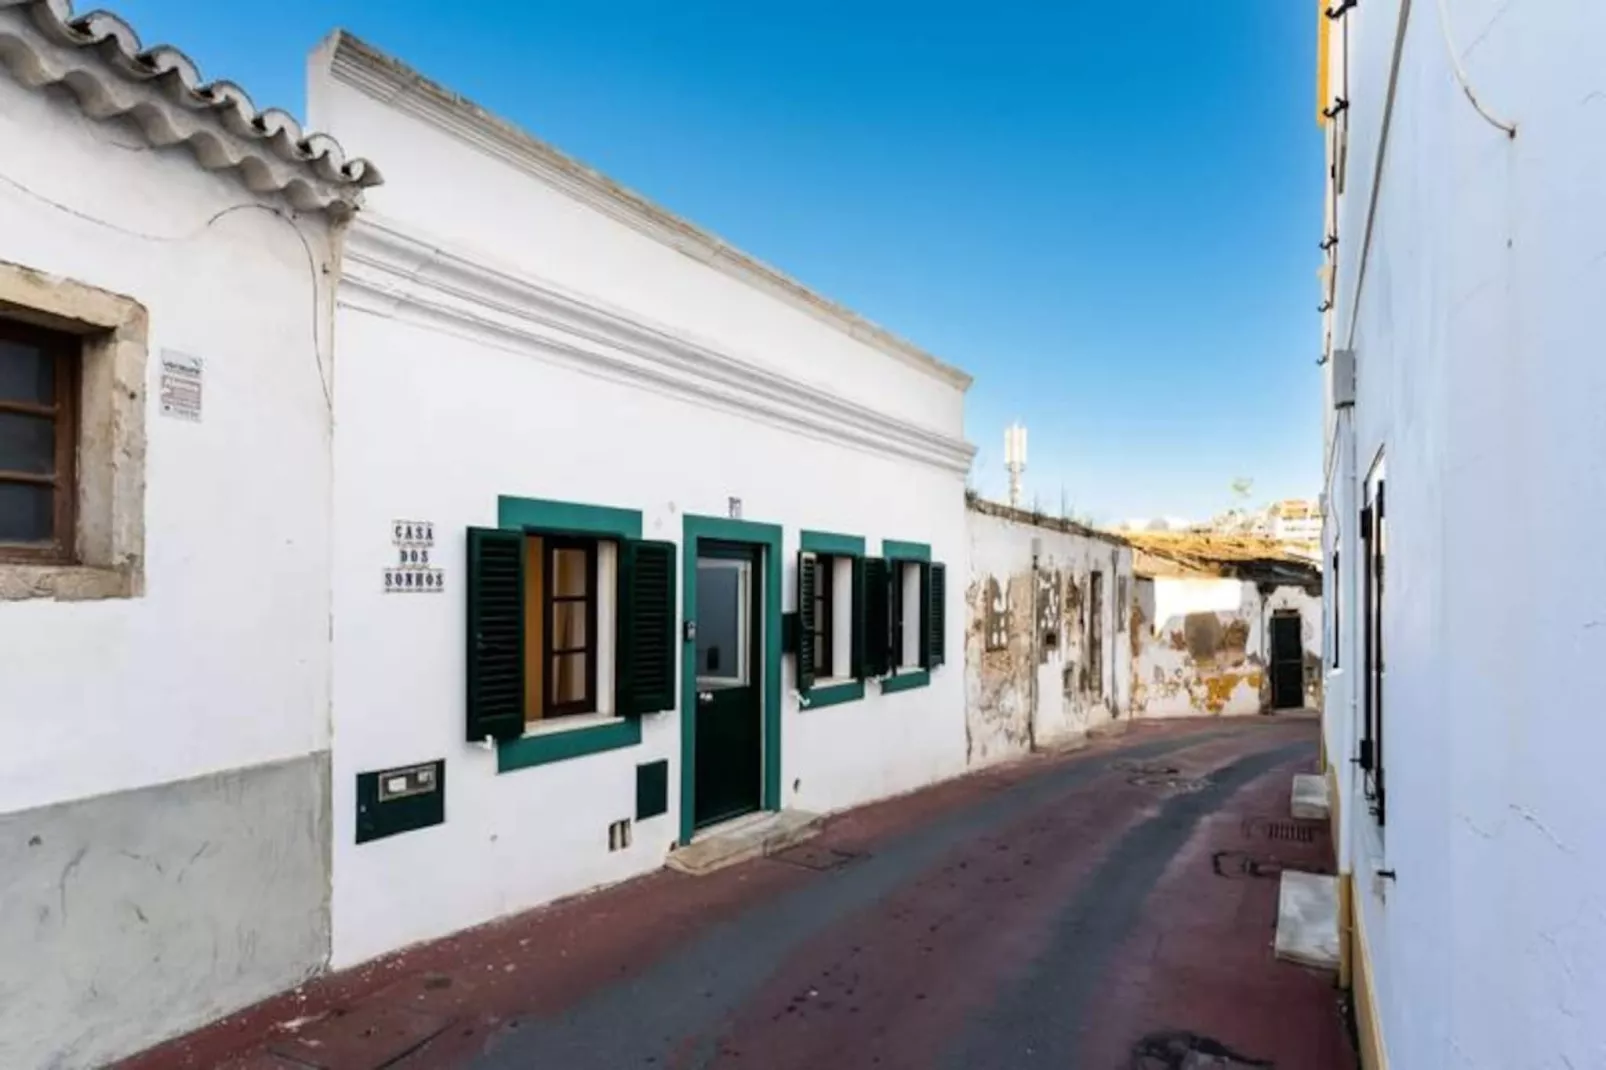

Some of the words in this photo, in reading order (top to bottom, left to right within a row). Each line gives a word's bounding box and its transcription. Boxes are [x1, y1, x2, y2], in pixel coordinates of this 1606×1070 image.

[395, 525, 433, 540] CASA
[400, 549, 428, 563] DOS
[385, 572, 444, 587] SONHOS
